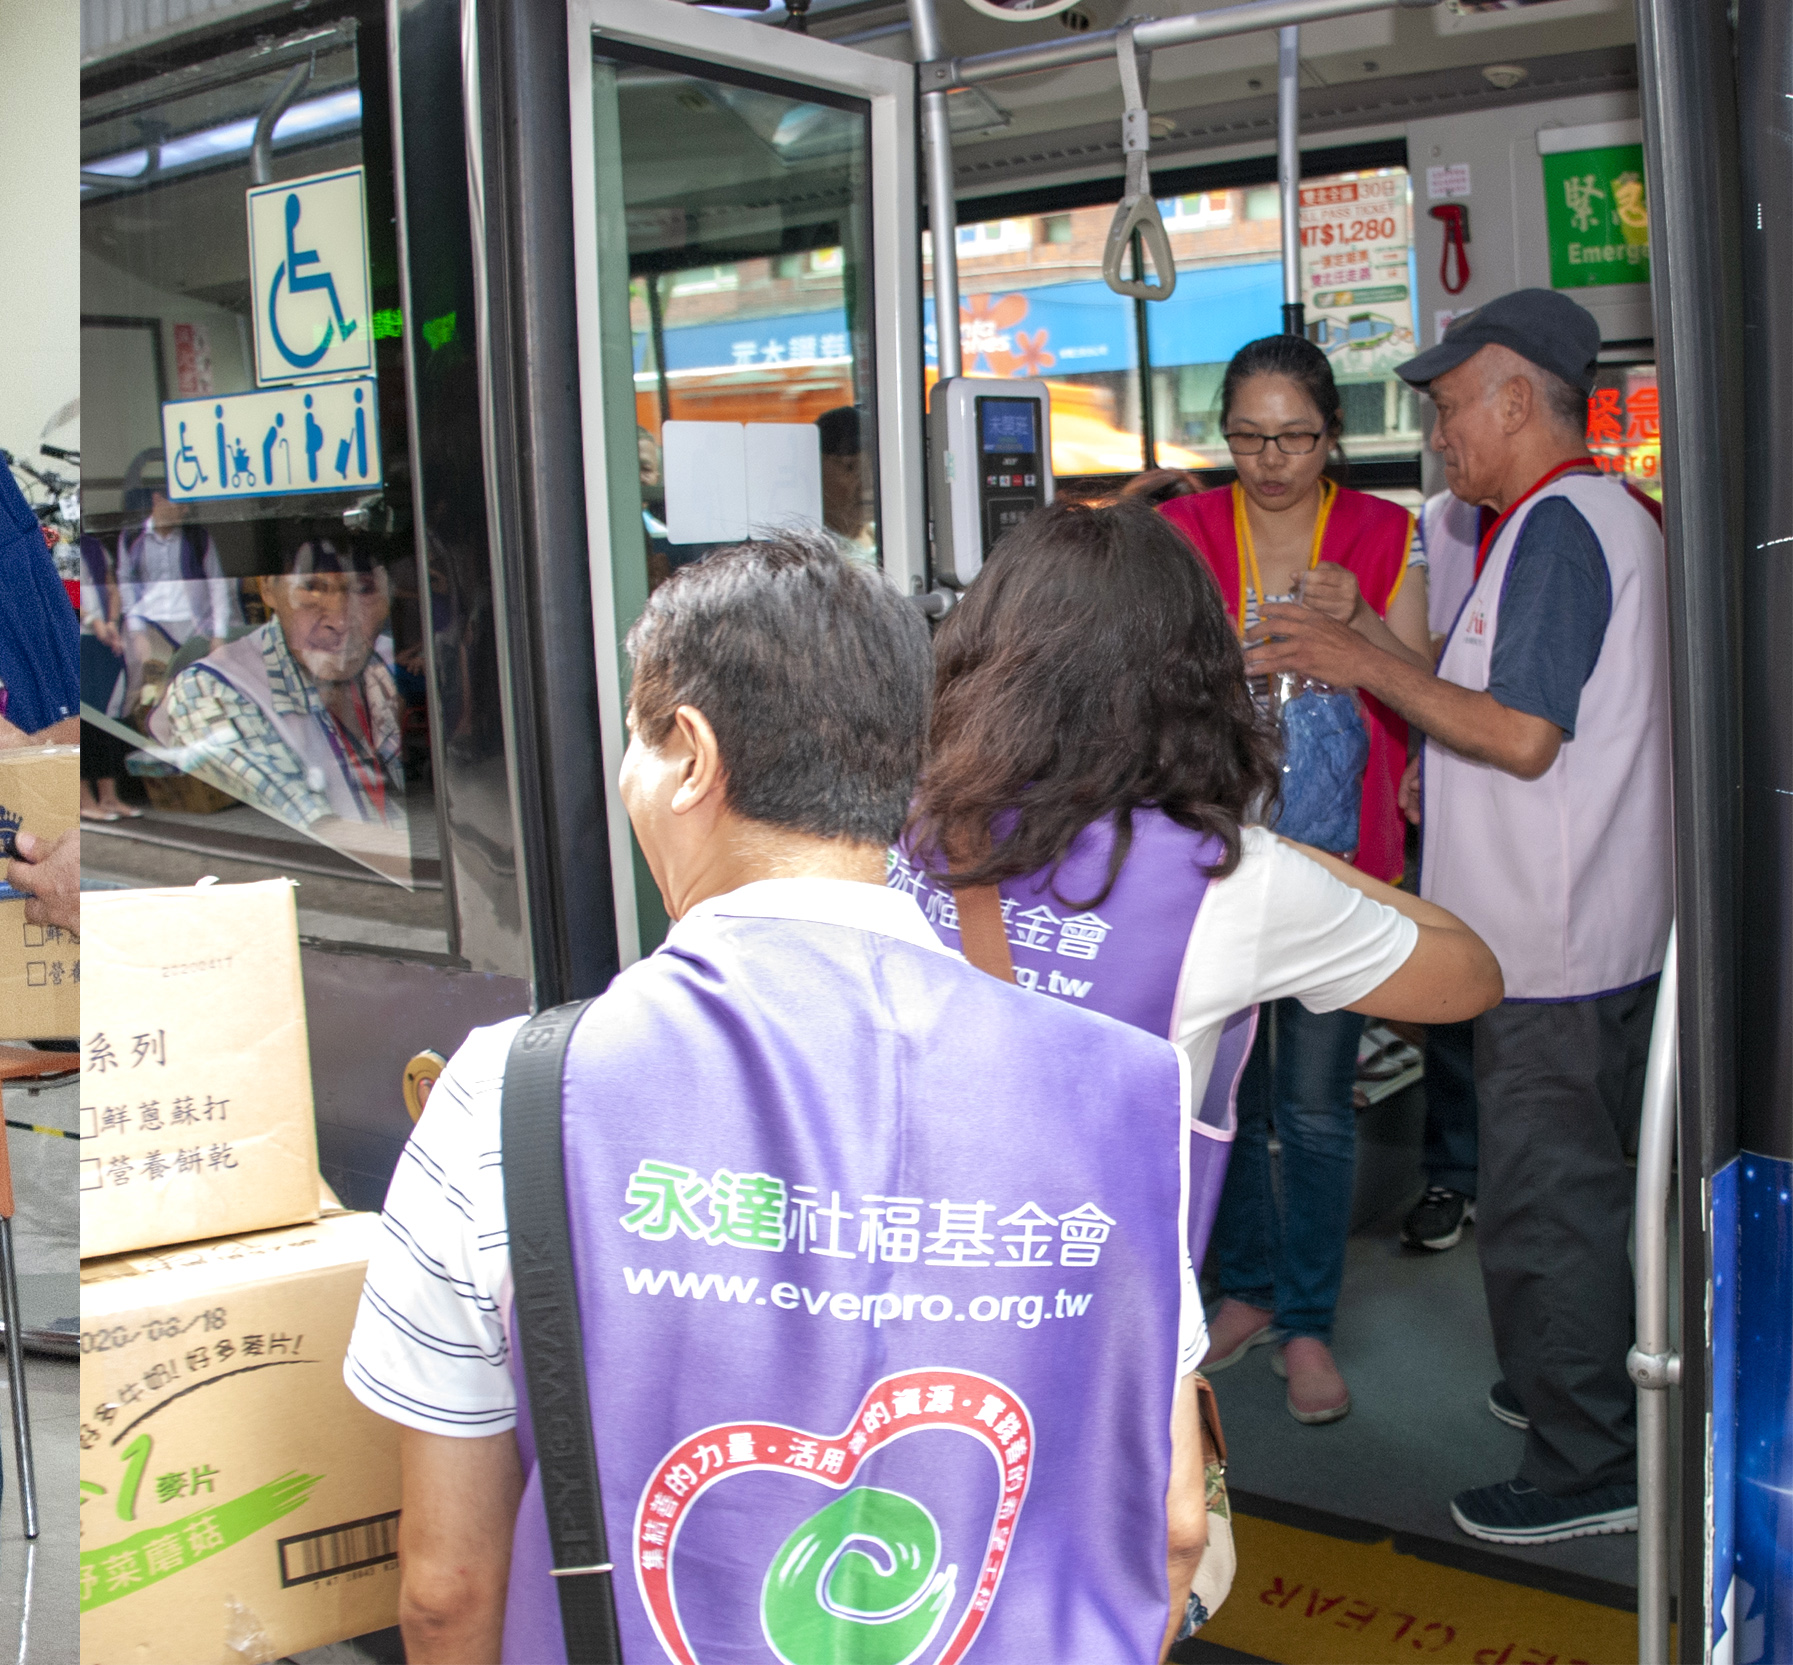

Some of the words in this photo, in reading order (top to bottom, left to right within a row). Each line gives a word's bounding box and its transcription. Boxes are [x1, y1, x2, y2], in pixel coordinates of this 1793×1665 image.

[86, 1028, 167, 1074] 系列
[106, 1142, 239, 1187] 營養餅乾
[620, 1157, 1117, 1268] 永達社福基金會
[622, 1266, 1095, 1330] www.everpro.org.tw
[154, 1463, 220, 1504] 麥片
[1259, 1576, 1457, 1654] CLEAR
